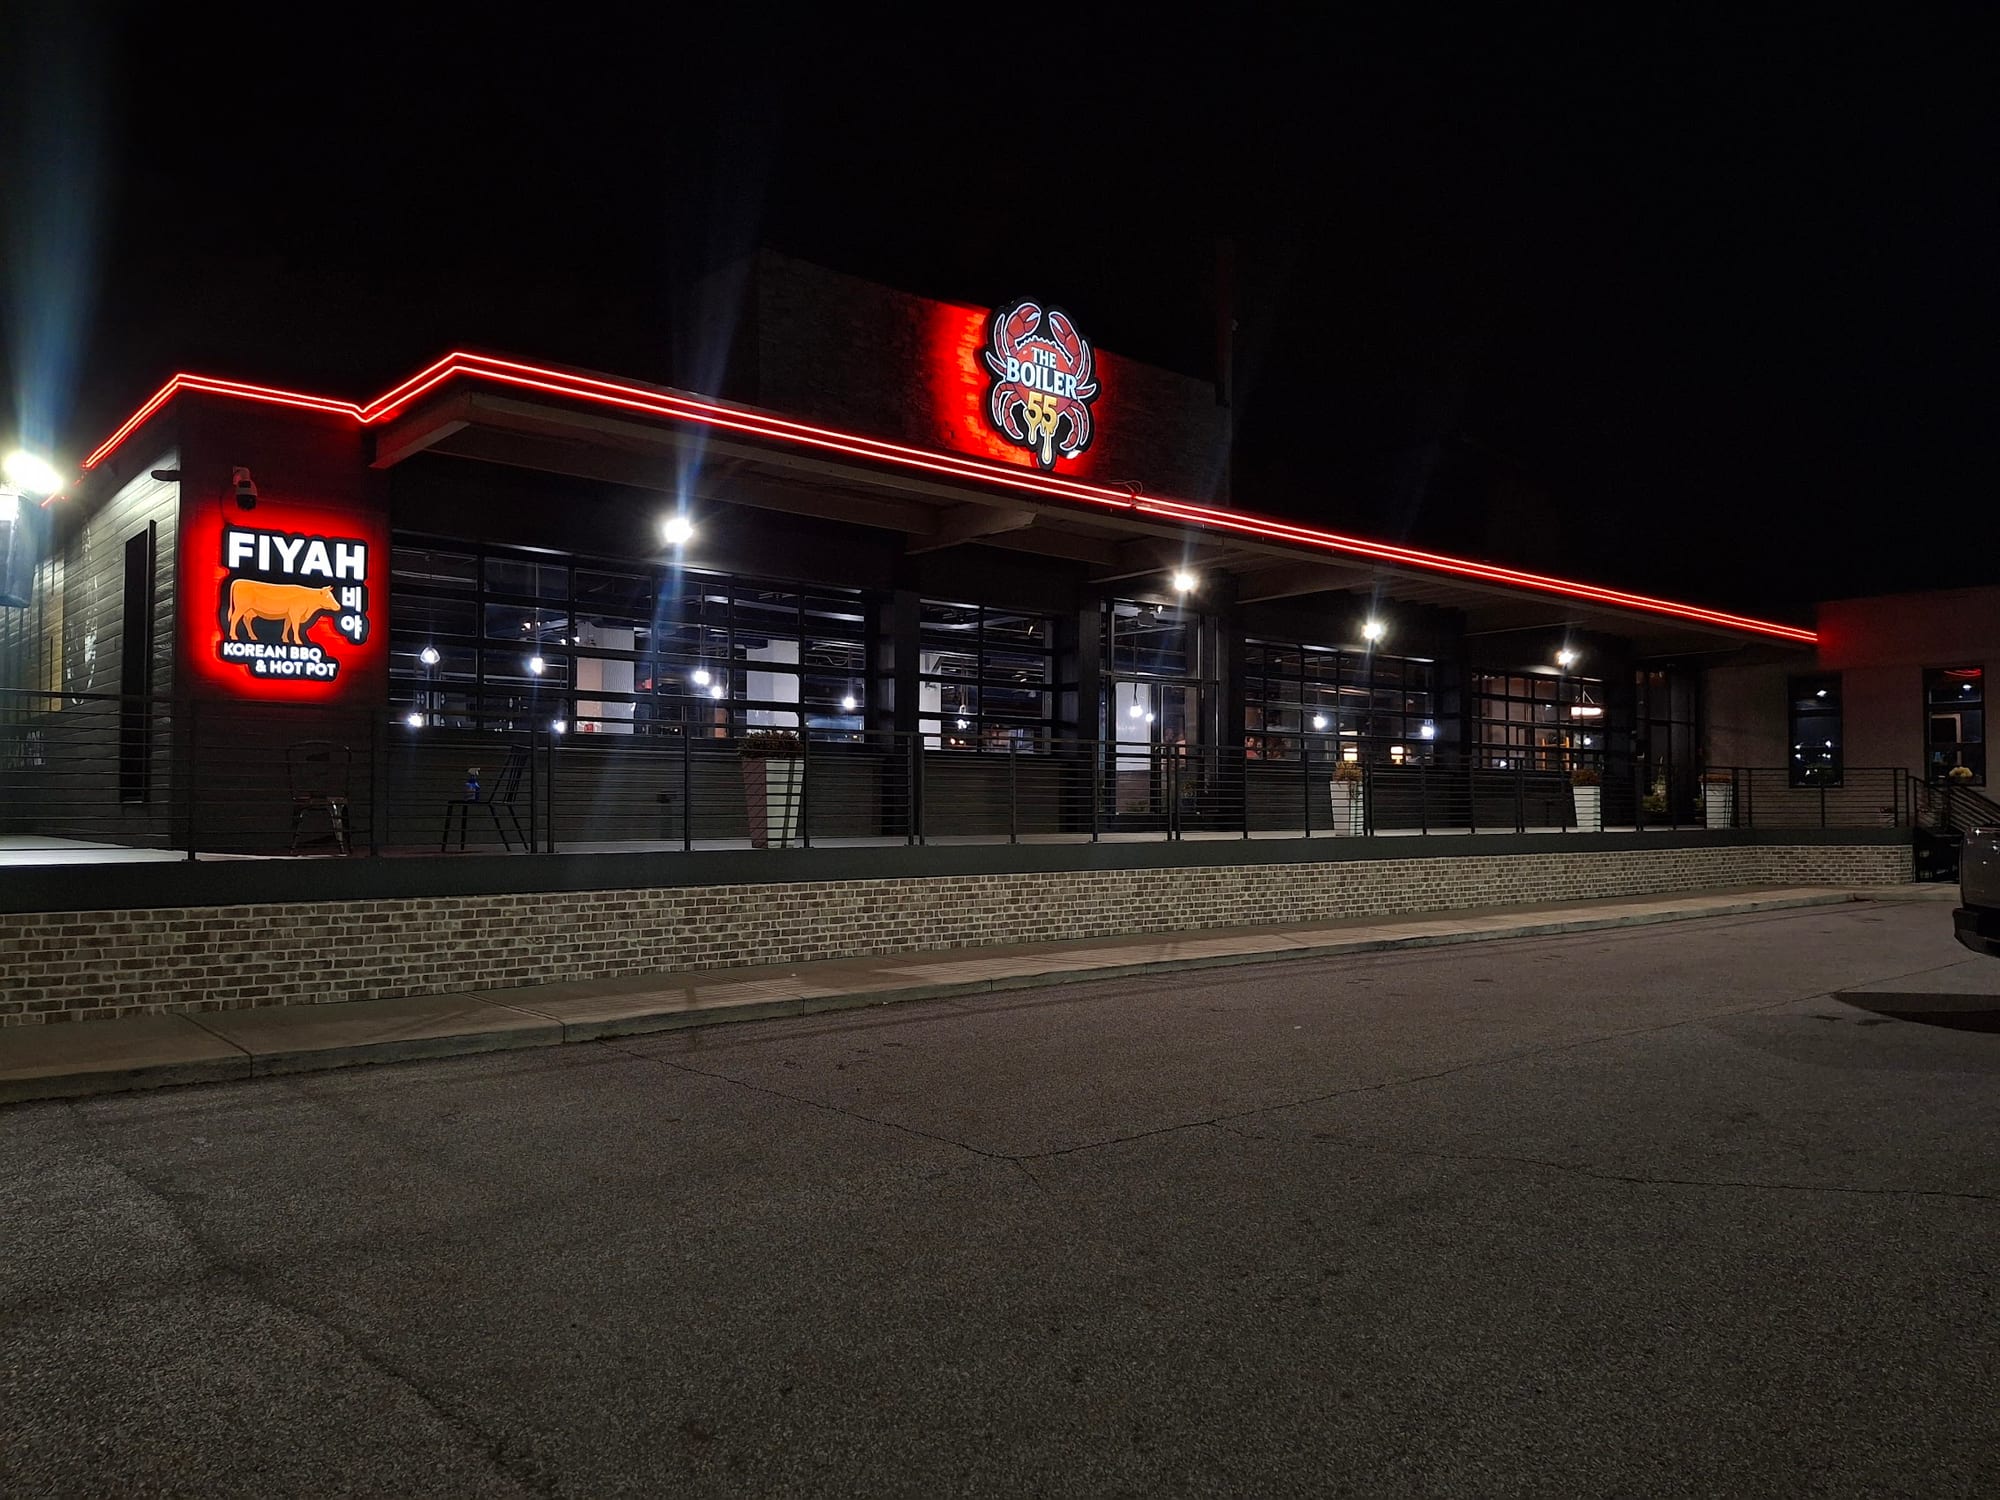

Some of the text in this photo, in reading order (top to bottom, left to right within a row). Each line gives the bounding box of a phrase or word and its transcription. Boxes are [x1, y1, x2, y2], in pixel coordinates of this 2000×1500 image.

[1031, 347, 1057, 369] THE
[1006, 356, 1079, 400] BOILER
[1027, 391, 1057, 433] 55
[228, 531, 365, 580] FIYAH
[223, 642, 322, 662] KOREAN BBQ
[255, 659, 337, 677] & HOT POT
